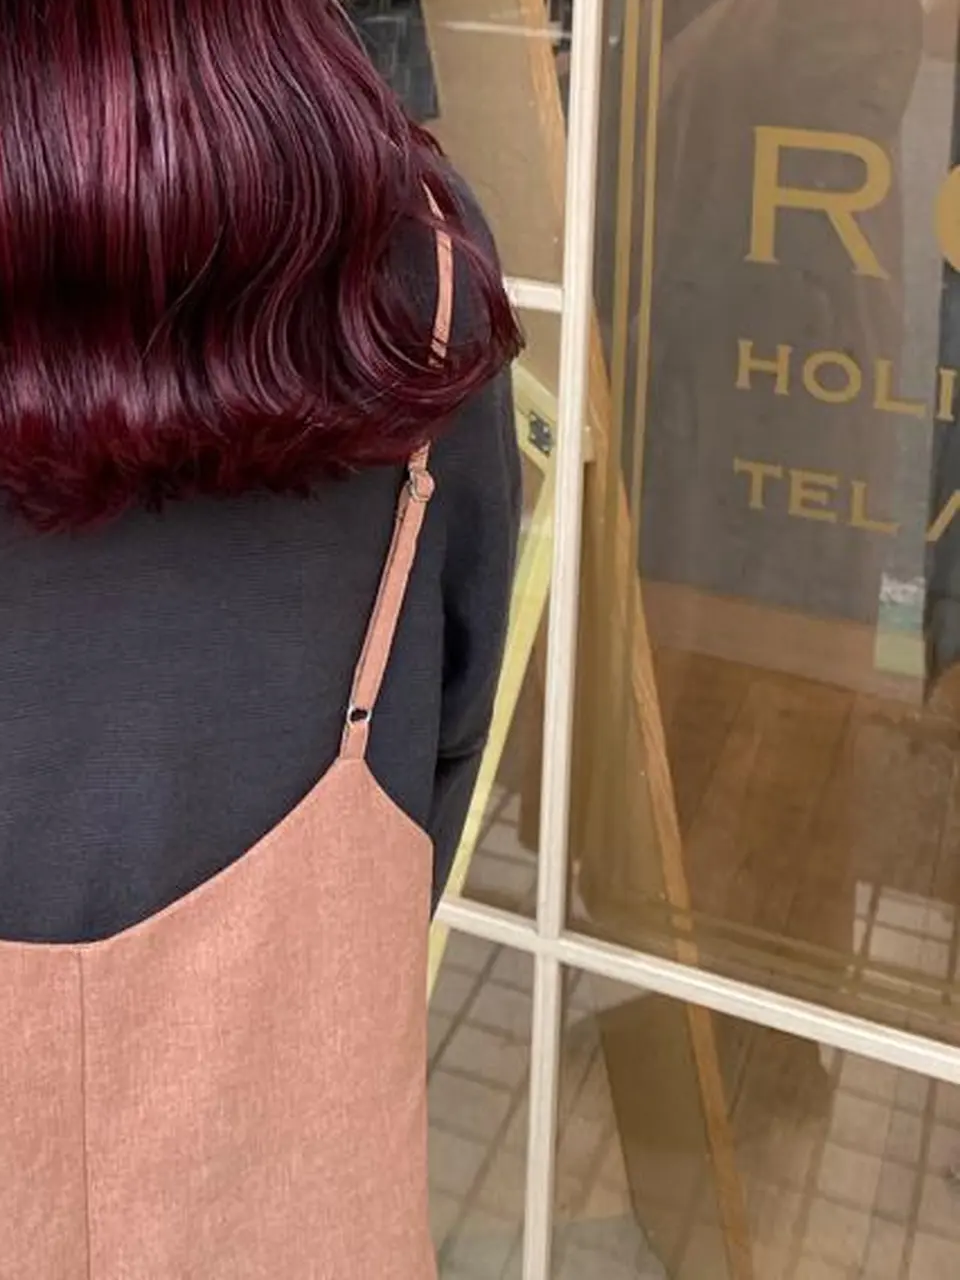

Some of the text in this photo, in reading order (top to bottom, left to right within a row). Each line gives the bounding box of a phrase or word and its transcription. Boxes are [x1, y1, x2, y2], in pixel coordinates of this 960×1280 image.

[744, 125, 960, 280] R
[735, 339, 956, 421] HOLI
[734, 458, 900, 534] TEL
